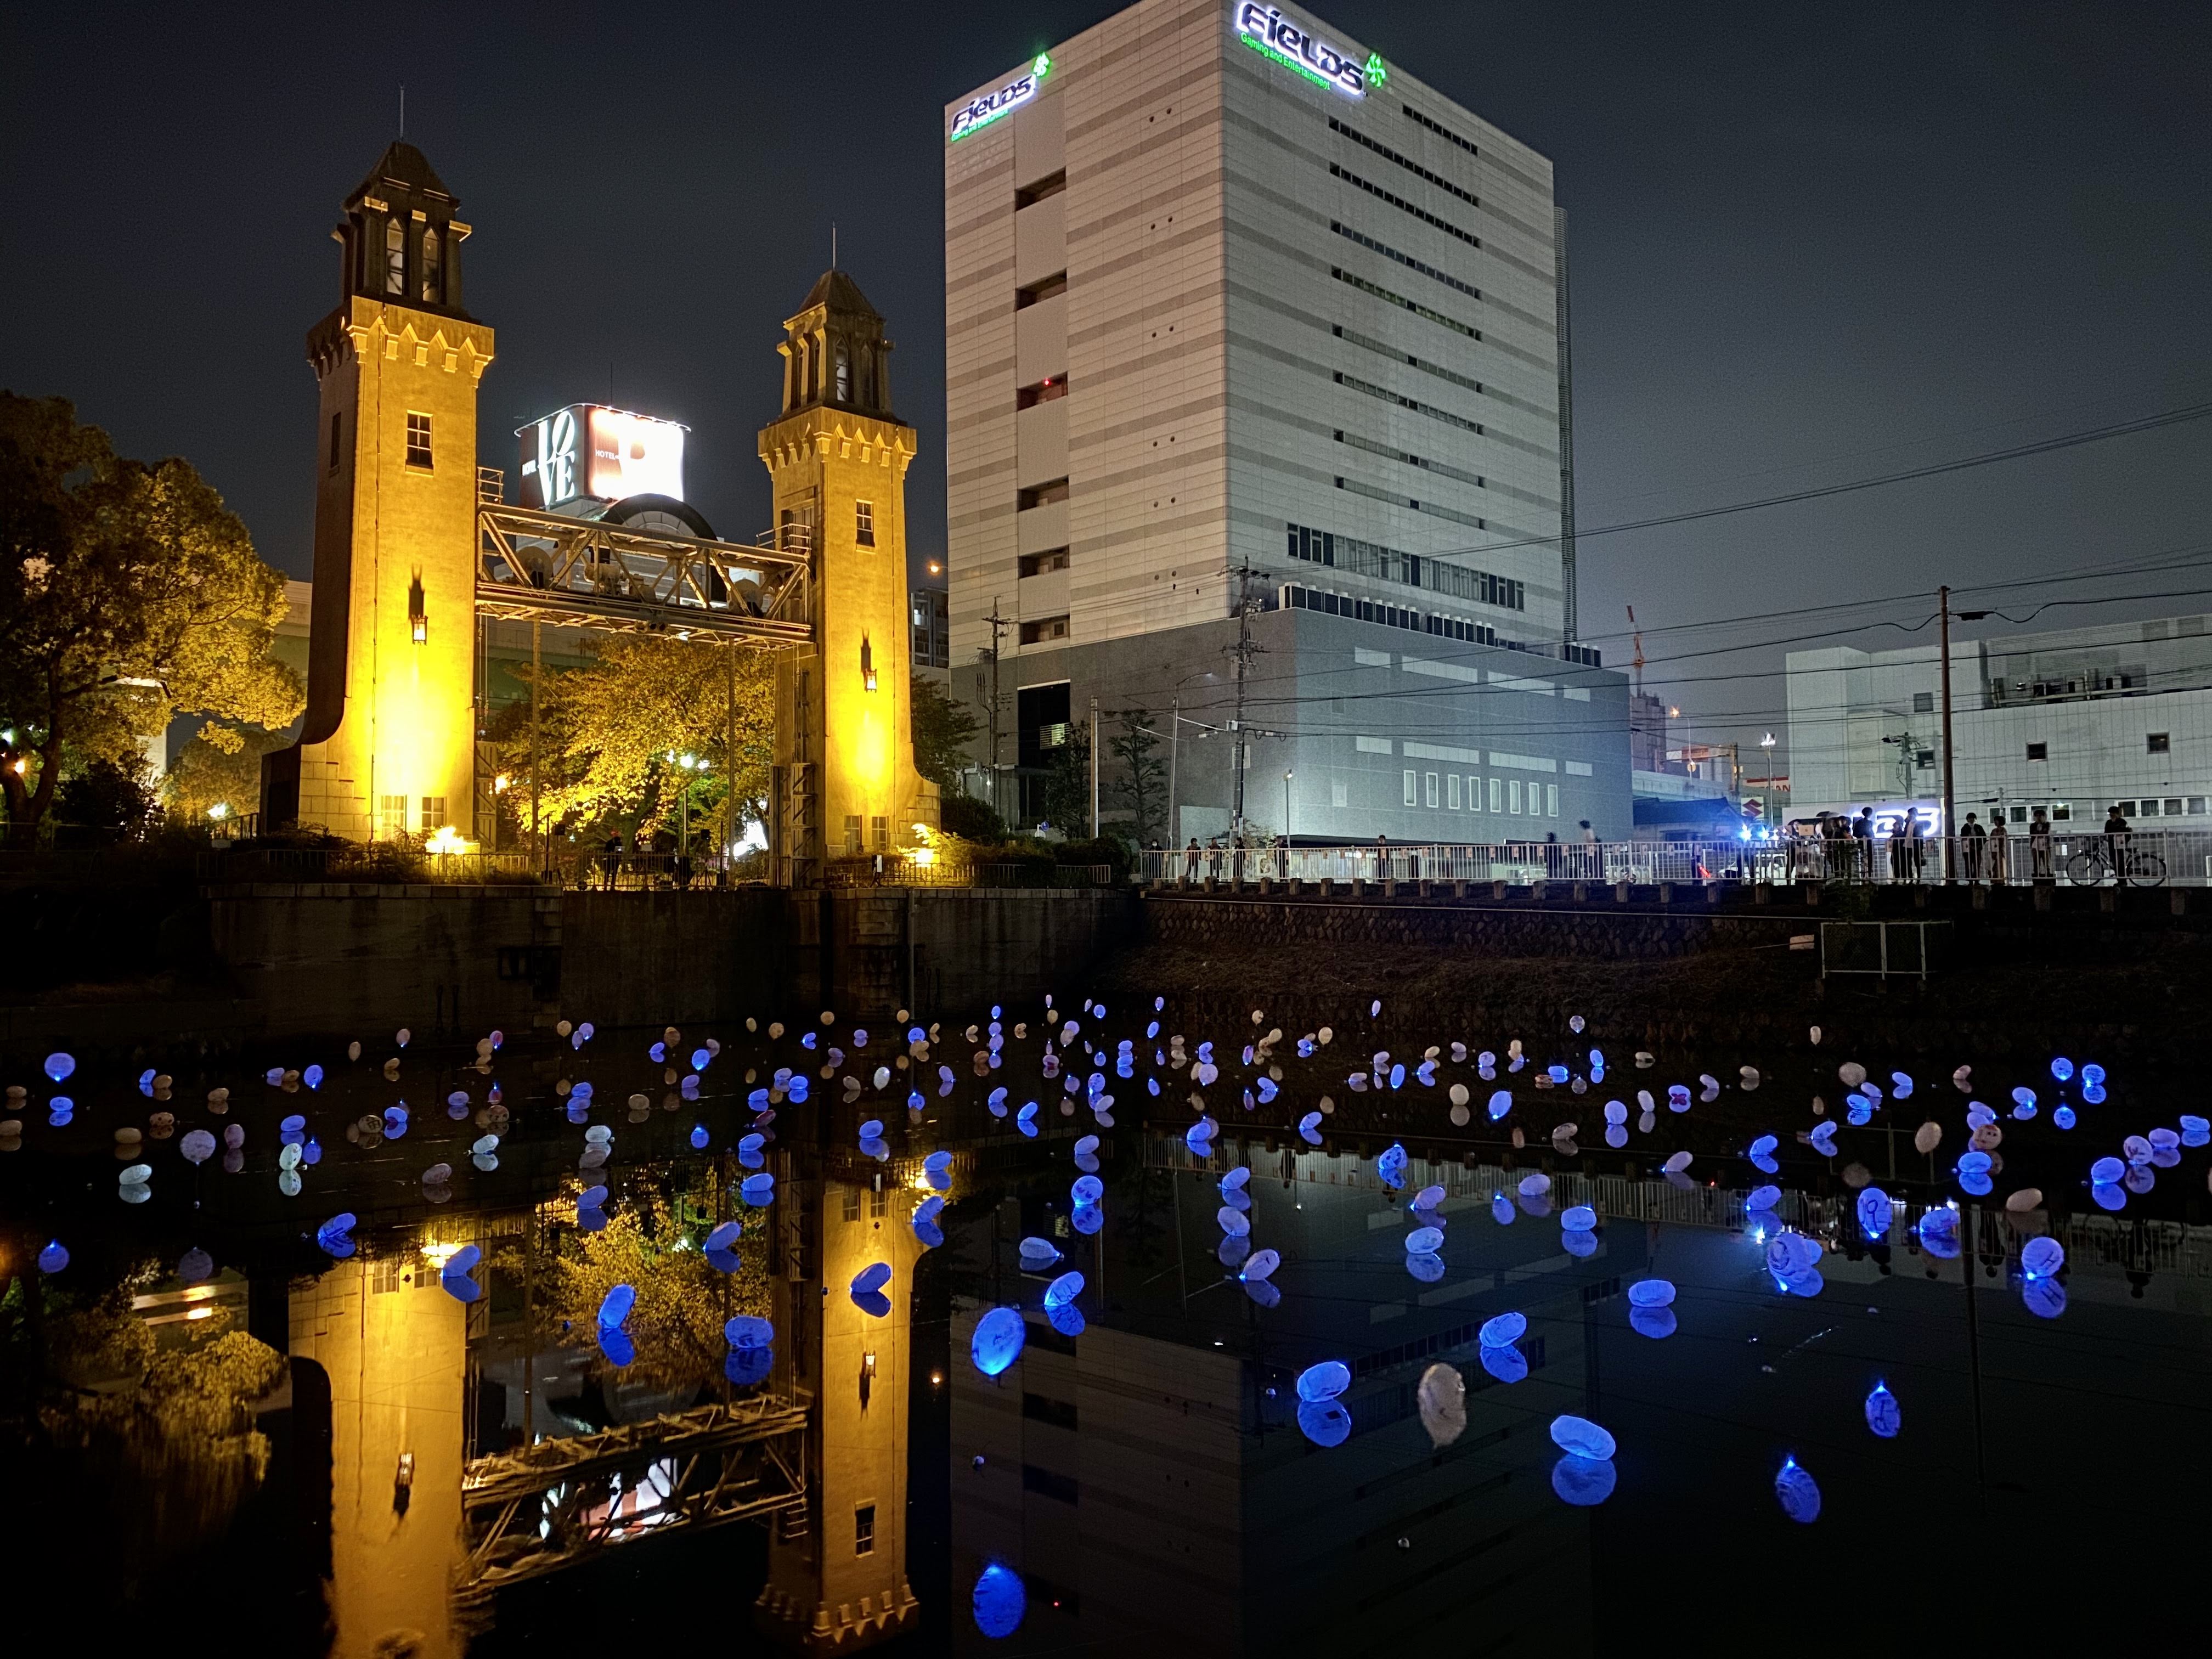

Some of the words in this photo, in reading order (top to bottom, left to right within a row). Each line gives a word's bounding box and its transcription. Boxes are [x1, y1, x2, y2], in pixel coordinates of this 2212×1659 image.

[1240, 32, 1269, 58] Gaming
[1269, 49, 1283, 65] and
[1283, 57, 1331, 91] Entertainment
[595, 449, 616, 460] HOTEL
